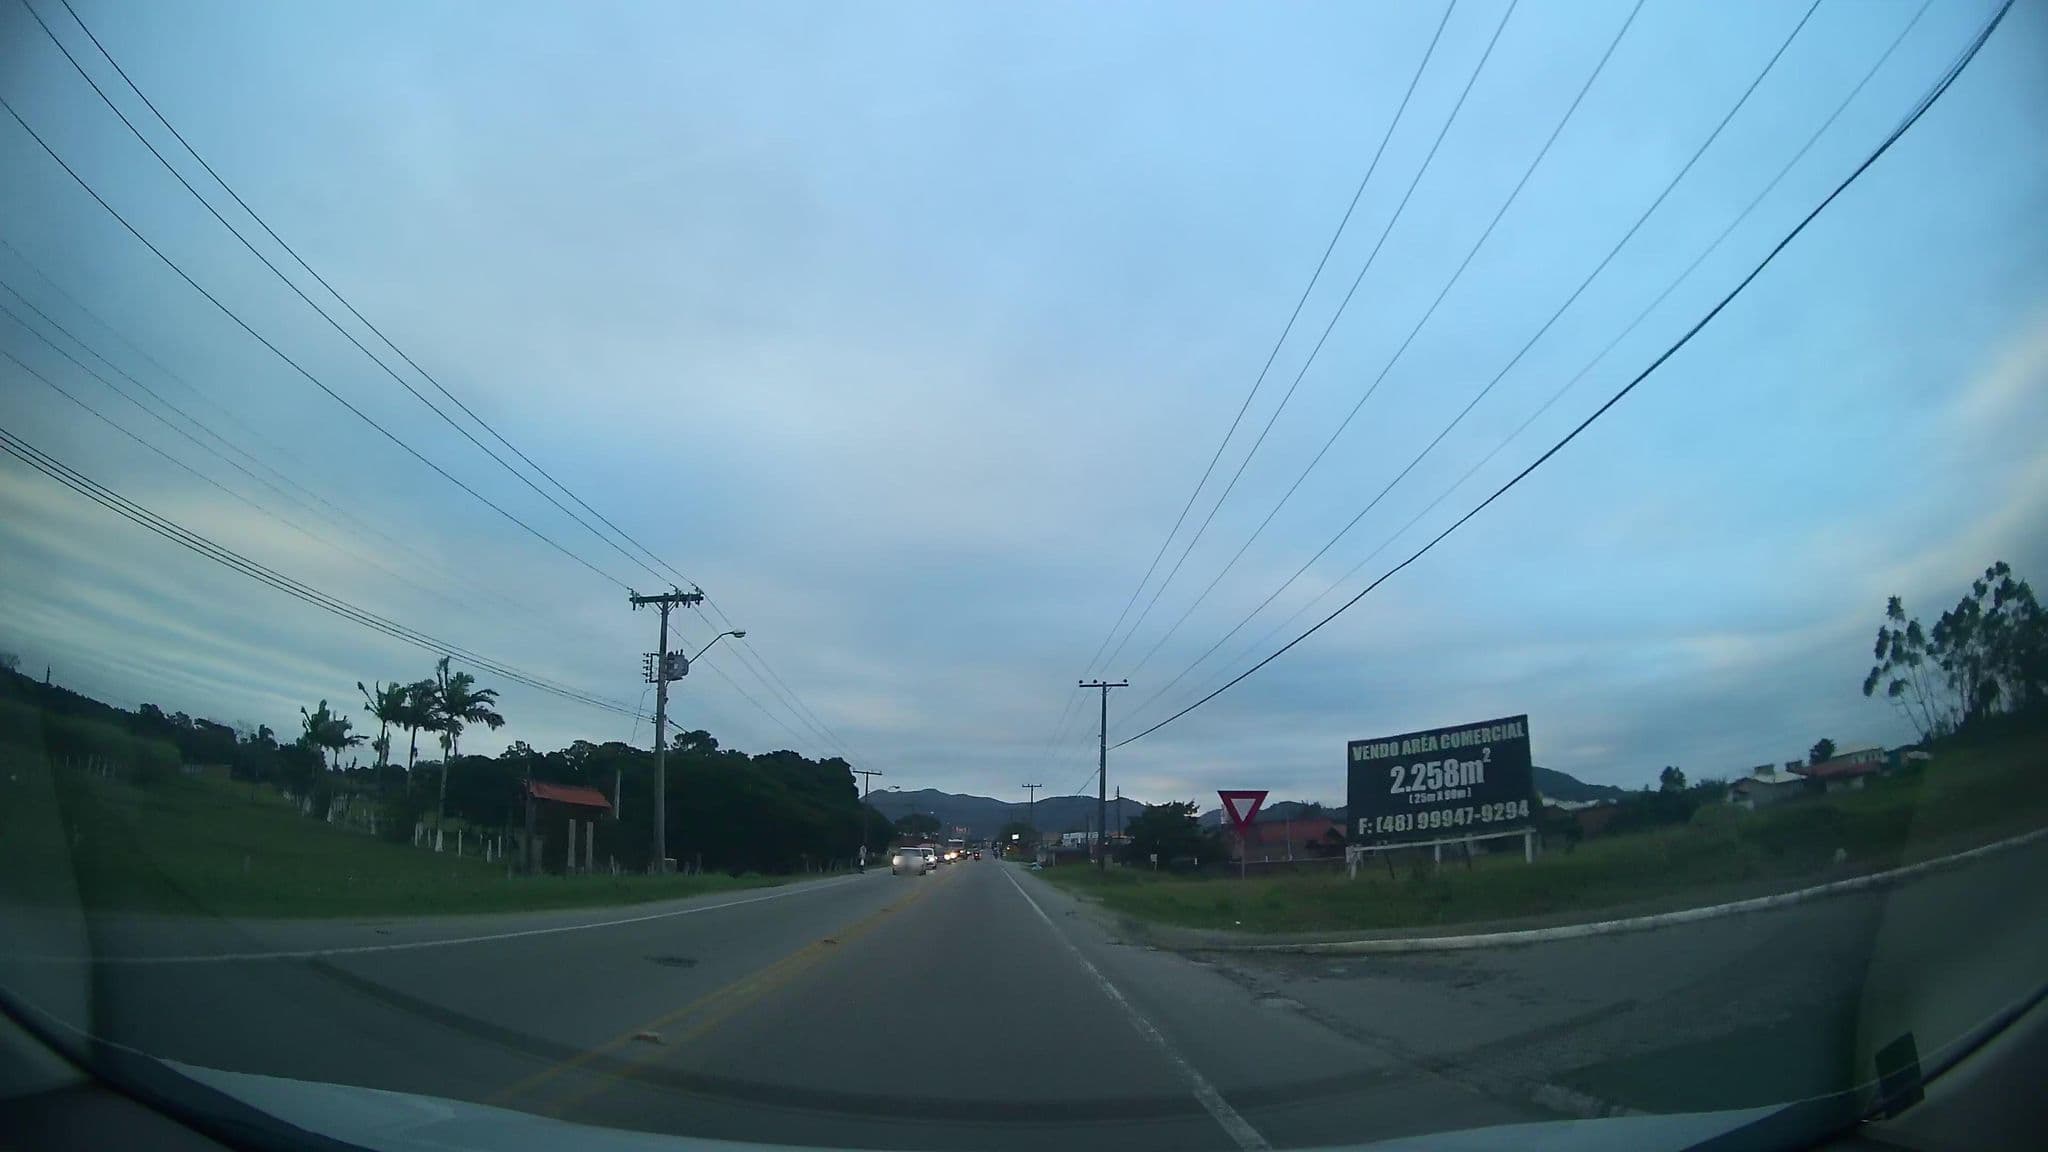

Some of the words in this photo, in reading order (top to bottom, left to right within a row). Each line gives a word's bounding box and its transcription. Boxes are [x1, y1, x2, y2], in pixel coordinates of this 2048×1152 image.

[1352, 742, 1399, 761] VENDO
[1440, 722, 1525, 750] COMERCIAL
[1358, 817, 1372, 835] F:
[1376, 814, 1413, 834] (48)
[1417, 799, 1530, 830] 99947-9294
